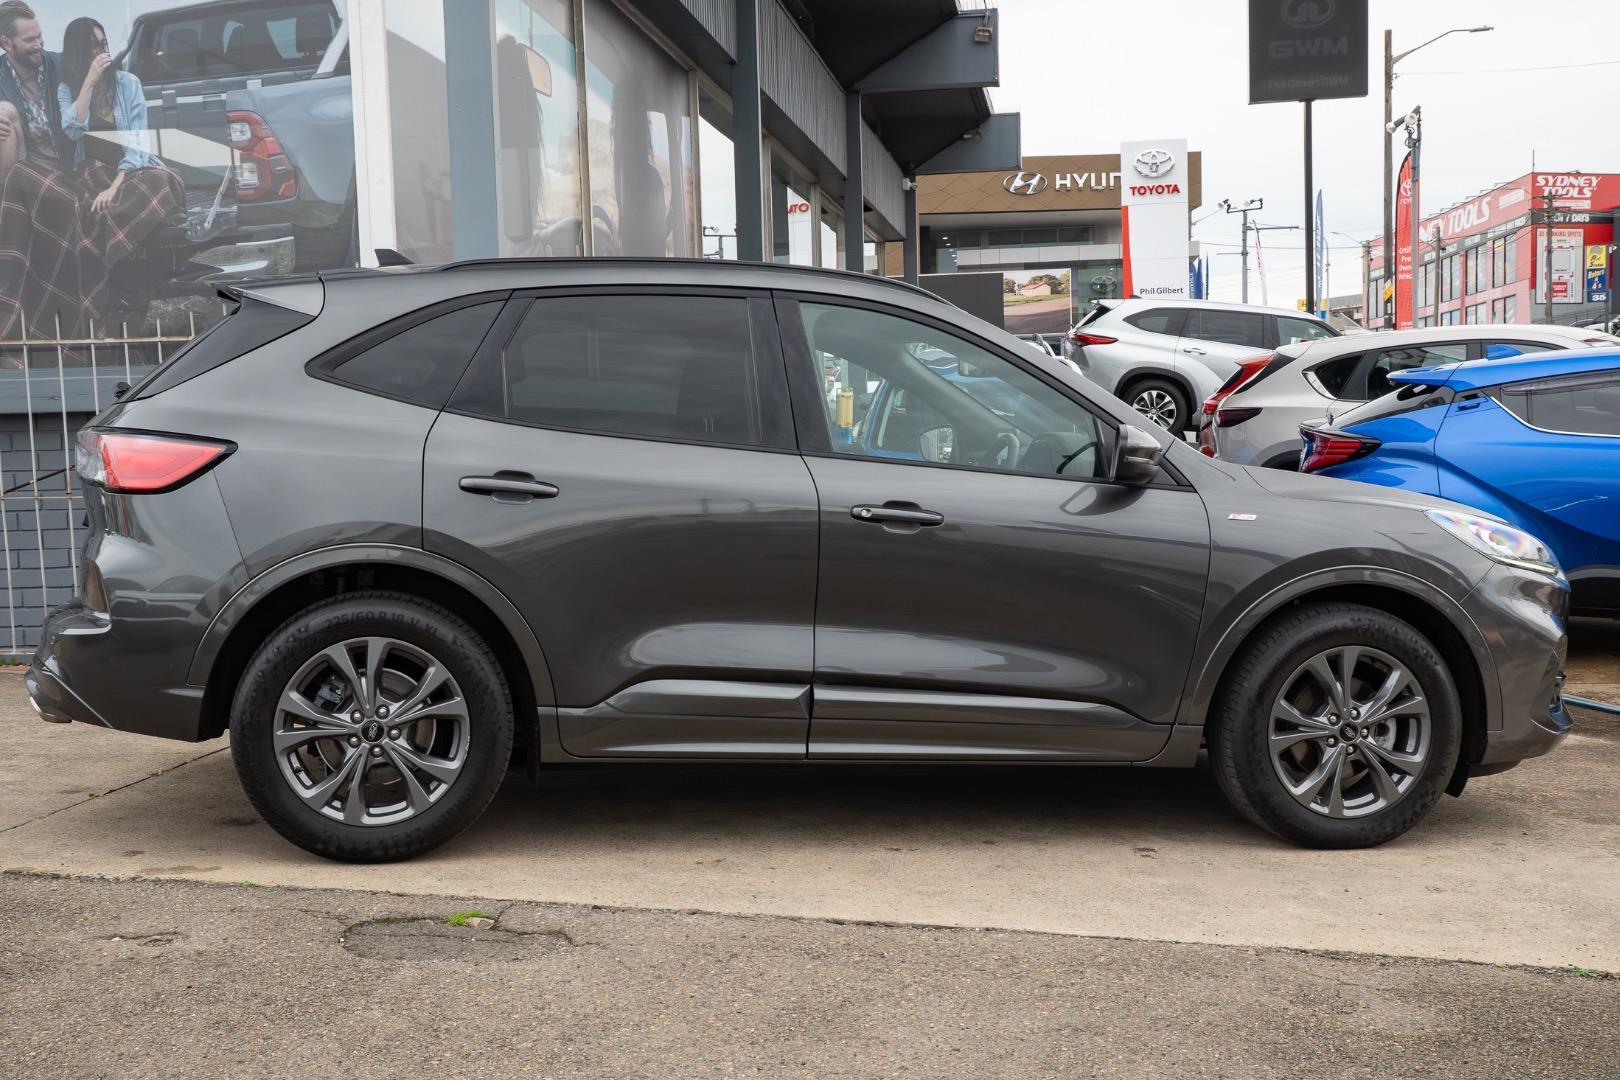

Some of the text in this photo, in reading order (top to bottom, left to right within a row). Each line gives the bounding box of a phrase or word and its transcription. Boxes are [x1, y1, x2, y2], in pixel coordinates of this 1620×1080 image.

[1268, 37, 1347, 58] GWM
[1536, 175, 1601, 187] SYDNEY
[1130, 184, 1180, 196] TOYOTA
[1542, 187, 1593, 198] TOOLS
[1447, 196, 1491, 236] TOOLS
[1571, 214, 1590, 222] DAYS
[1140, 287, 1184, 295] Phil Gilbert
